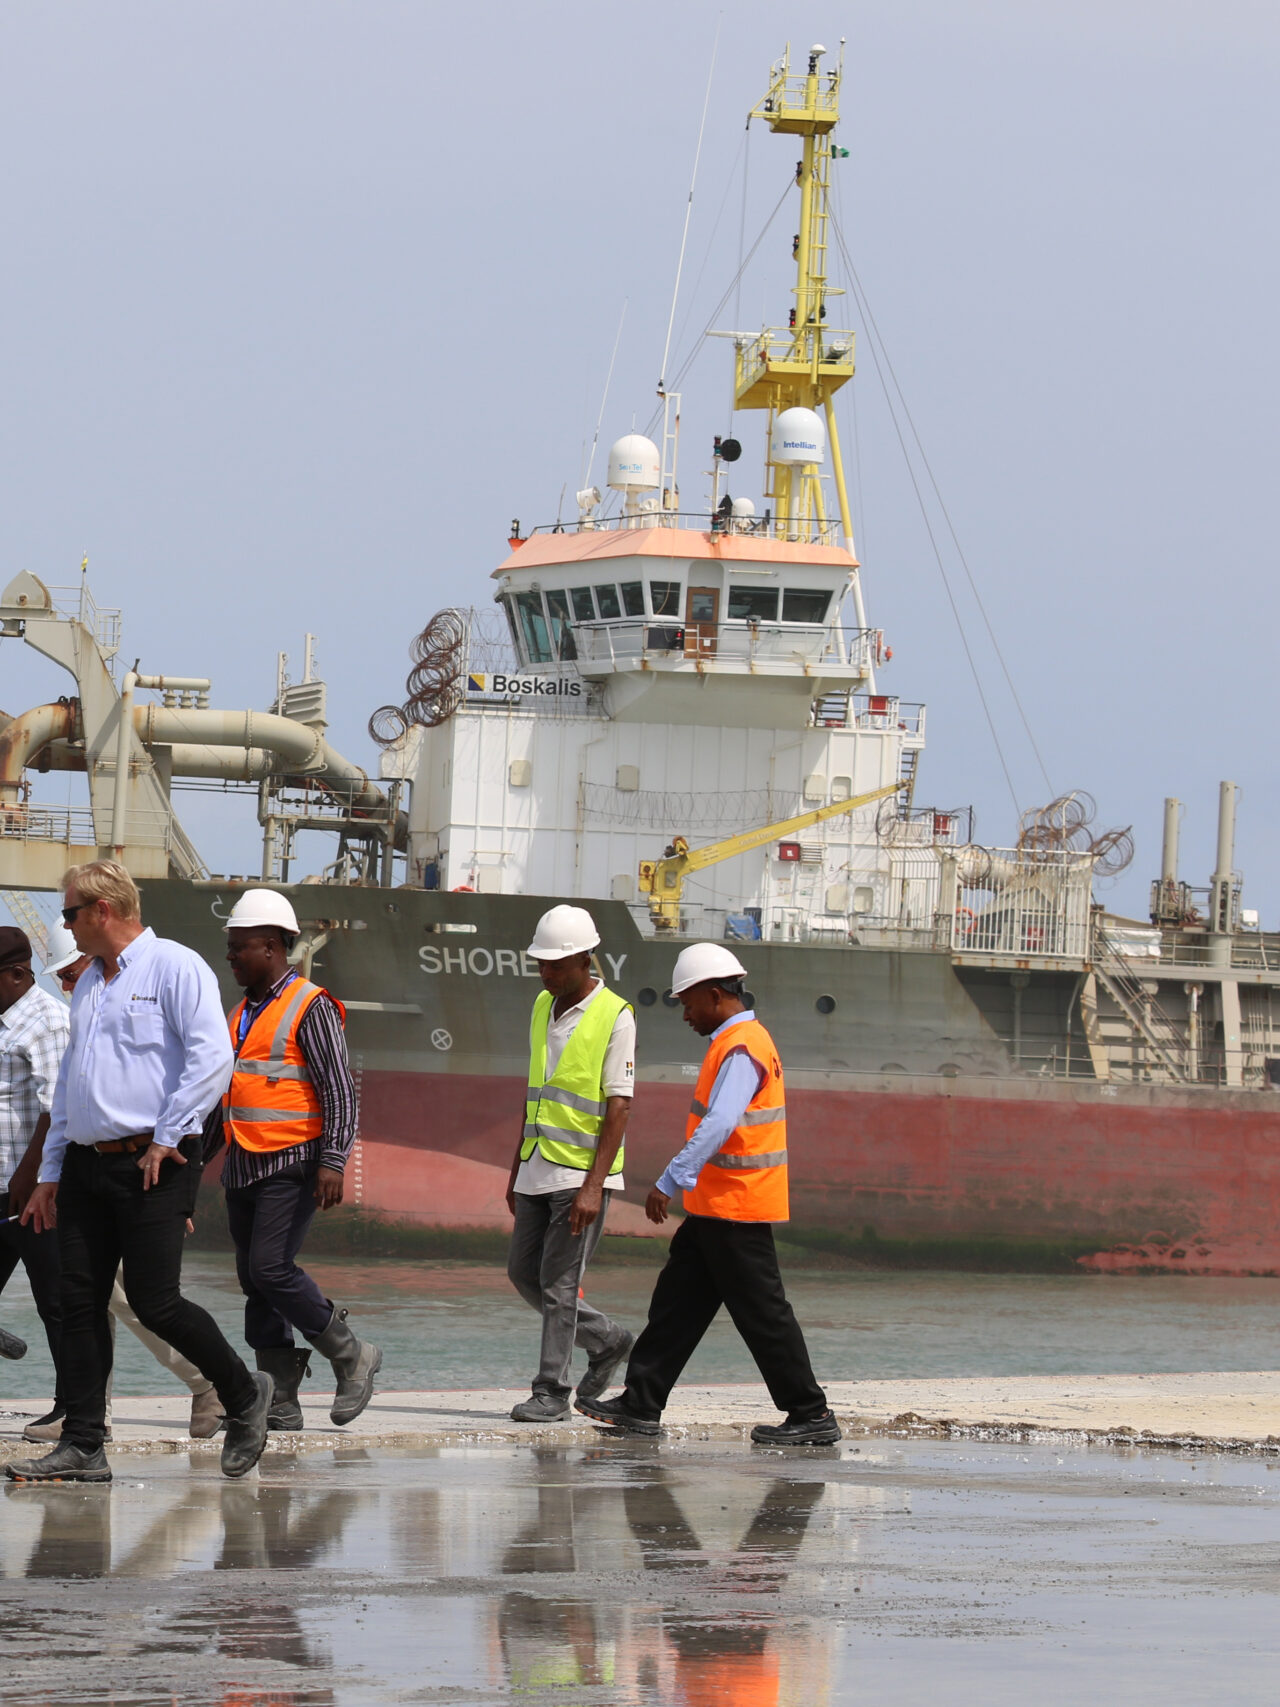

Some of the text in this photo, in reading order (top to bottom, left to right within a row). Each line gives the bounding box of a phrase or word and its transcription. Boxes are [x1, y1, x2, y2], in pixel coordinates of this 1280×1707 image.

[783, 441, 817, 450] Intellian
[493, 675, 581, 696] Boskalis
[419, 945, 627, 981] SHOREAY
